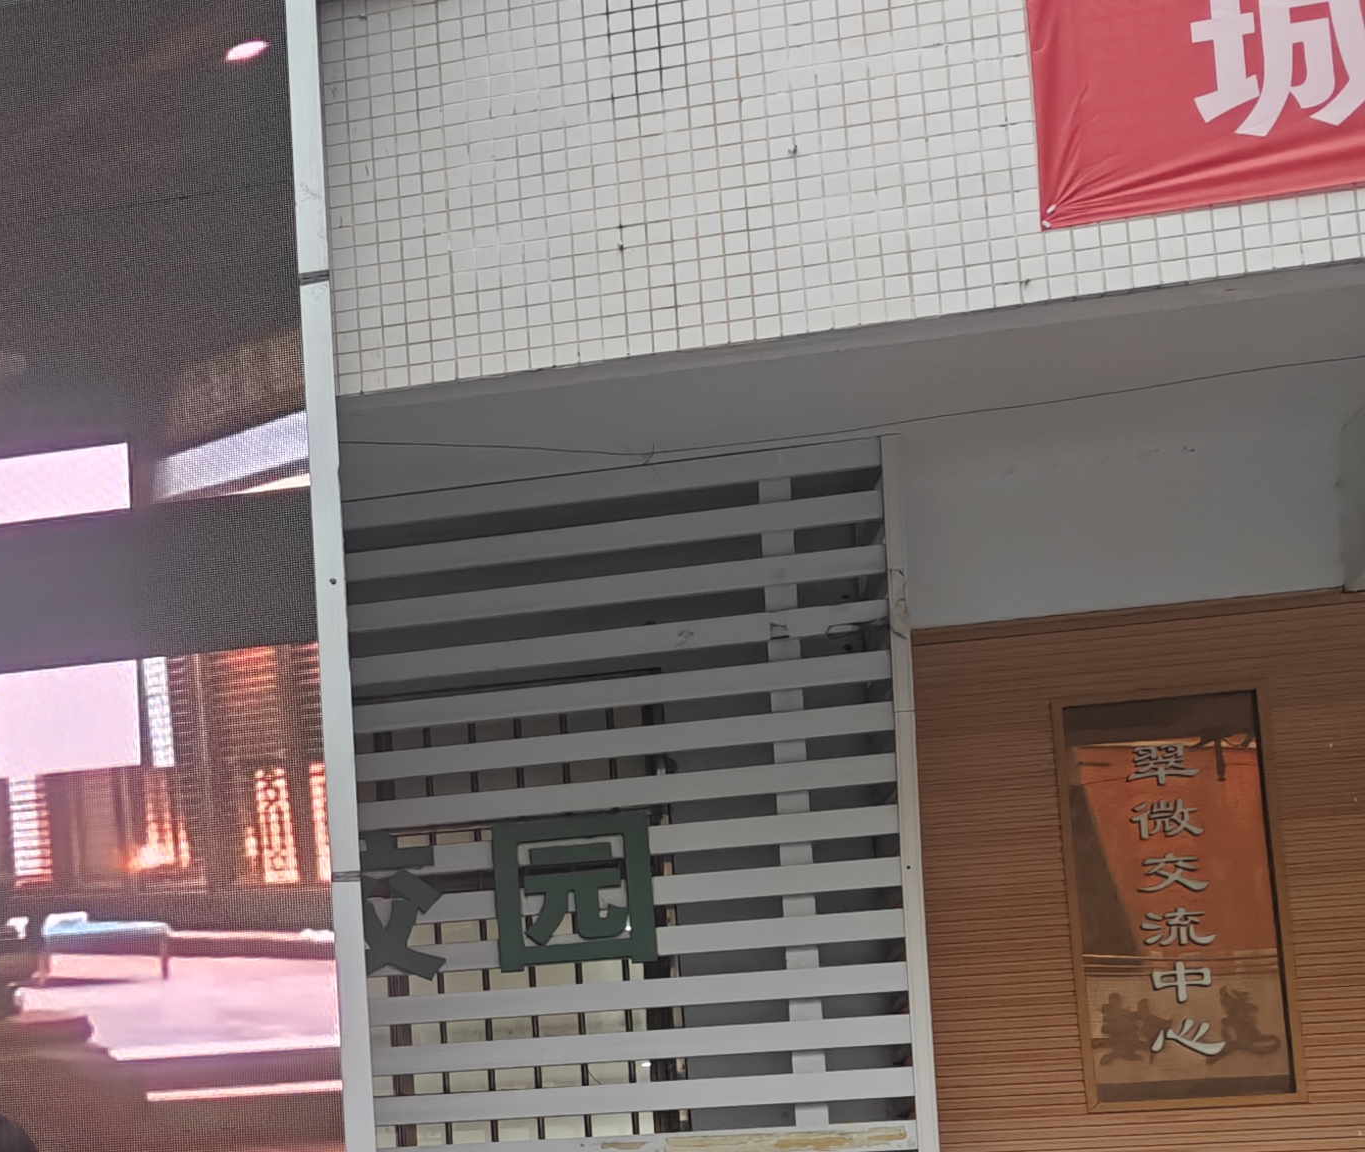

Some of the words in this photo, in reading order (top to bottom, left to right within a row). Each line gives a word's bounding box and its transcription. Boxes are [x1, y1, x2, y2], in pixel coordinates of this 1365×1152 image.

[1125, 742, 1227, 1056] 翠微交流中心
